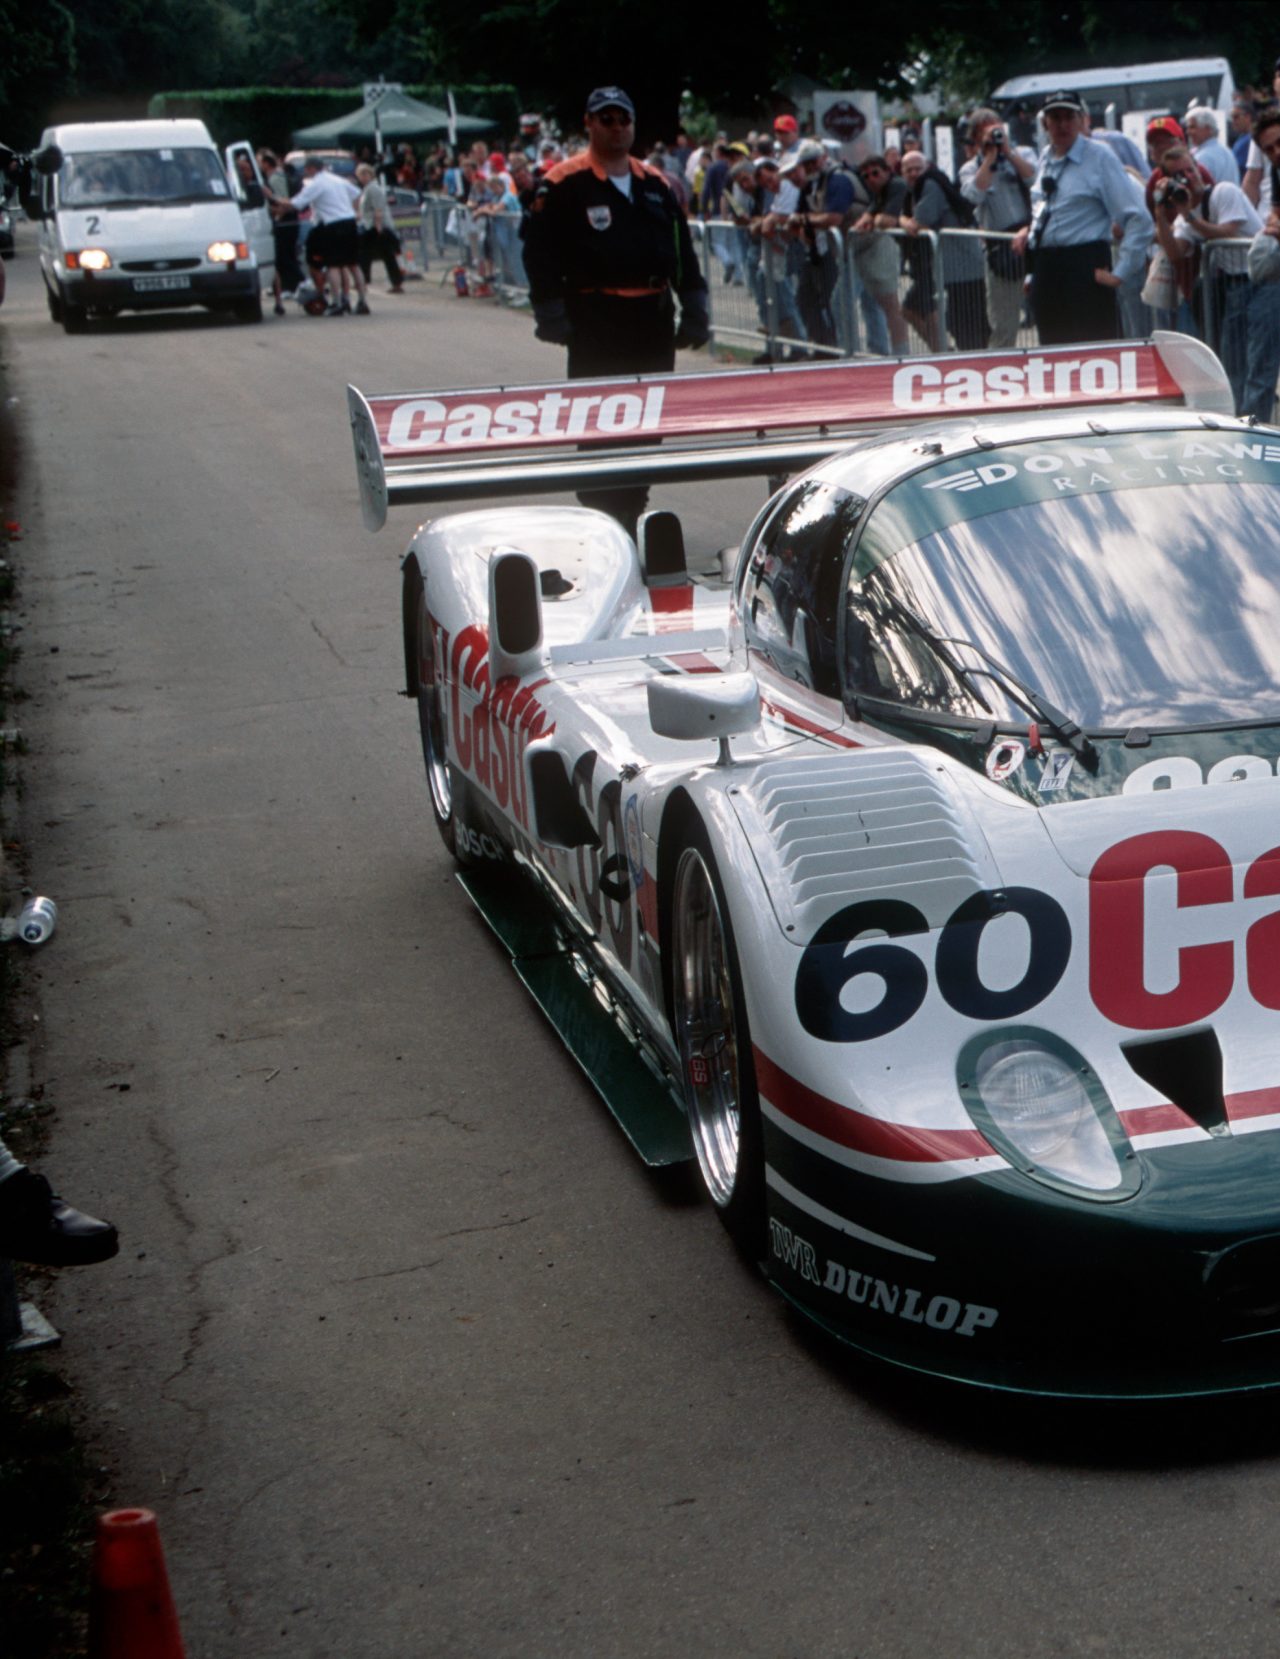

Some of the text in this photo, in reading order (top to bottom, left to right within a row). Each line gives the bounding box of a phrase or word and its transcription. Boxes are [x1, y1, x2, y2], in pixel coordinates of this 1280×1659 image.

[86, 215, 101, 236] 2
[387, 350, 1138, 449] Castrol Castrol
[978, 442, 1265, 487] DON LAW
[1052, 463, 1244, 491] RACING
[451, 623, 557, 836] Castr
[794, 886, 1073, 1043] 60
[822, 1259, 1000, 1337] DUNLOP
